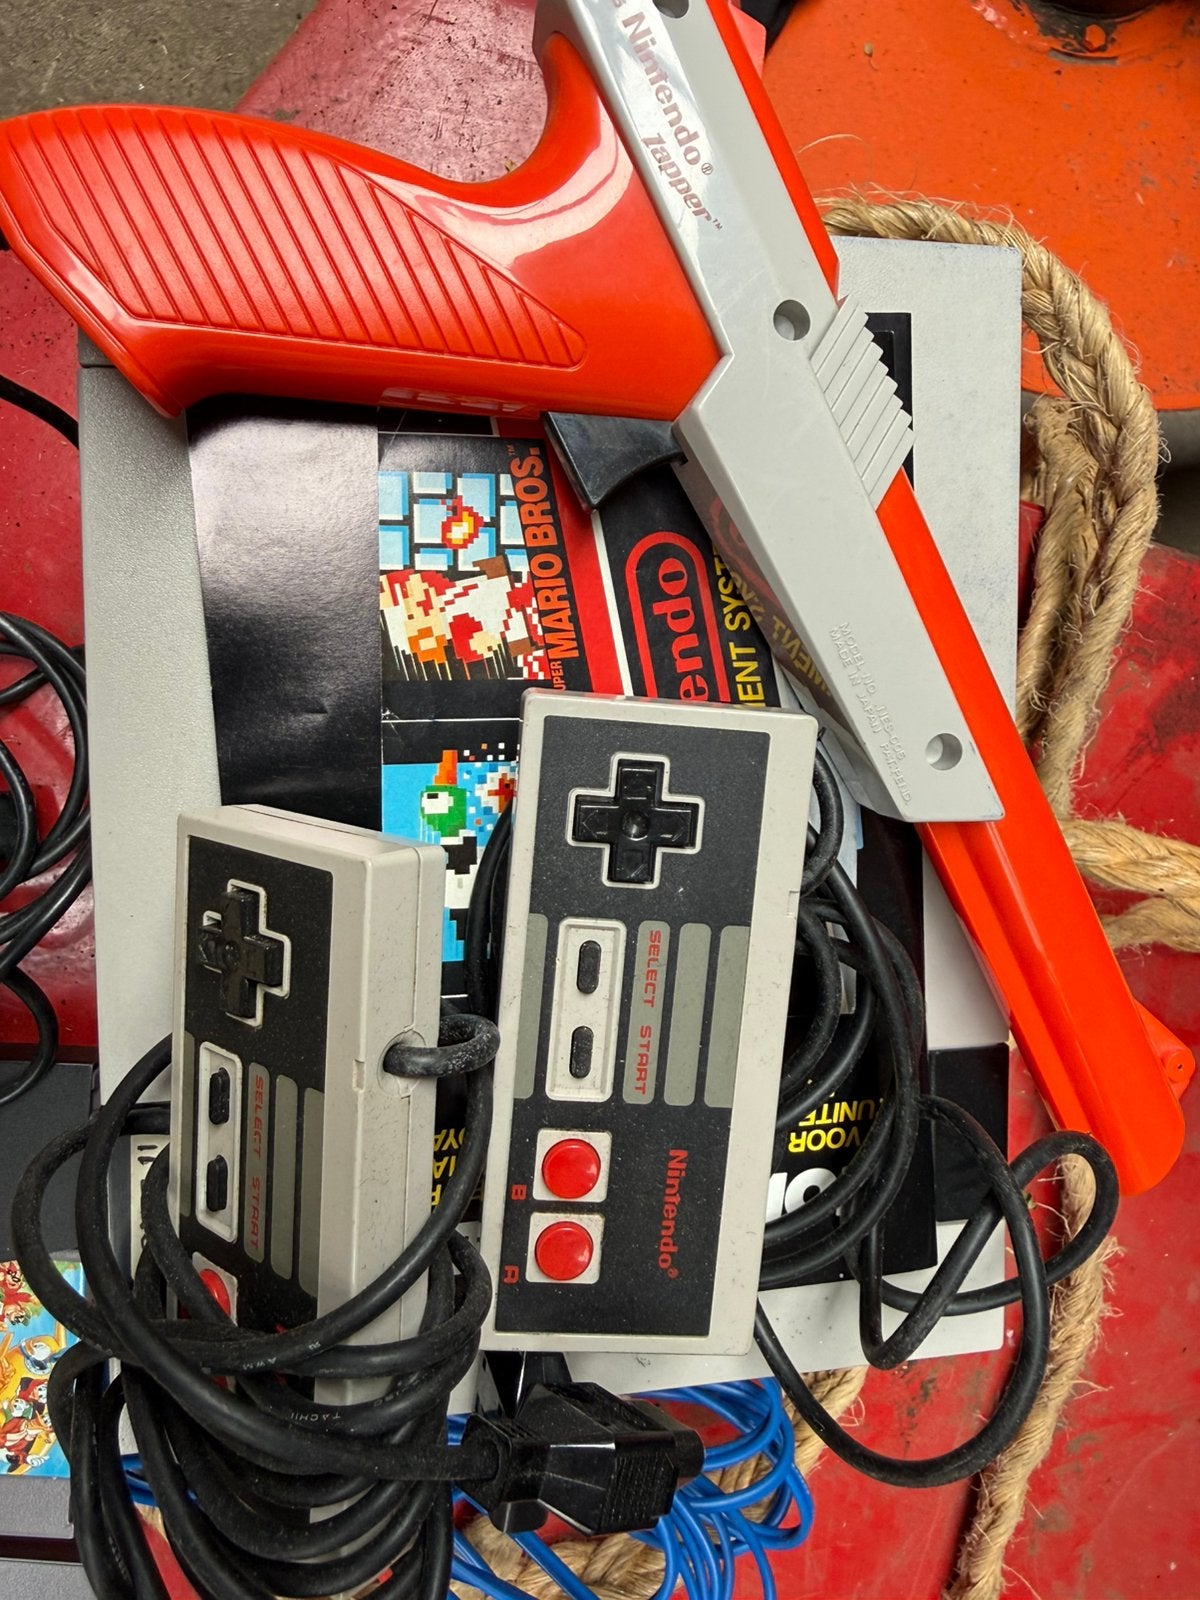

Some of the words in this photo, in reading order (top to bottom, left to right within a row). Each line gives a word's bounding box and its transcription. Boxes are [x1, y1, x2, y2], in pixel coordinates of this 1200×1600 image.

[530, 552, 580, 660] MARIO
[713, 544, 752, 632] SYST
[652, 557, 709, 701] endo
[829, 628, 854, 669] MADE
[839, 621, 866, 673] MODEL
[550, 660, 567, 691] UPER
[848, 673, 864, 688] IN
[855, 692, 882, 735] JAPAN
[643, 929, 662, 1009] SELECT
[634, 1024, 653, 1096] START
[252, 1074, 264, 1160] SELECT
[248, 1177, 262, 1251] START
[510, 1183, 528, 1201] B
[502, 1264, 520, 1285] A
